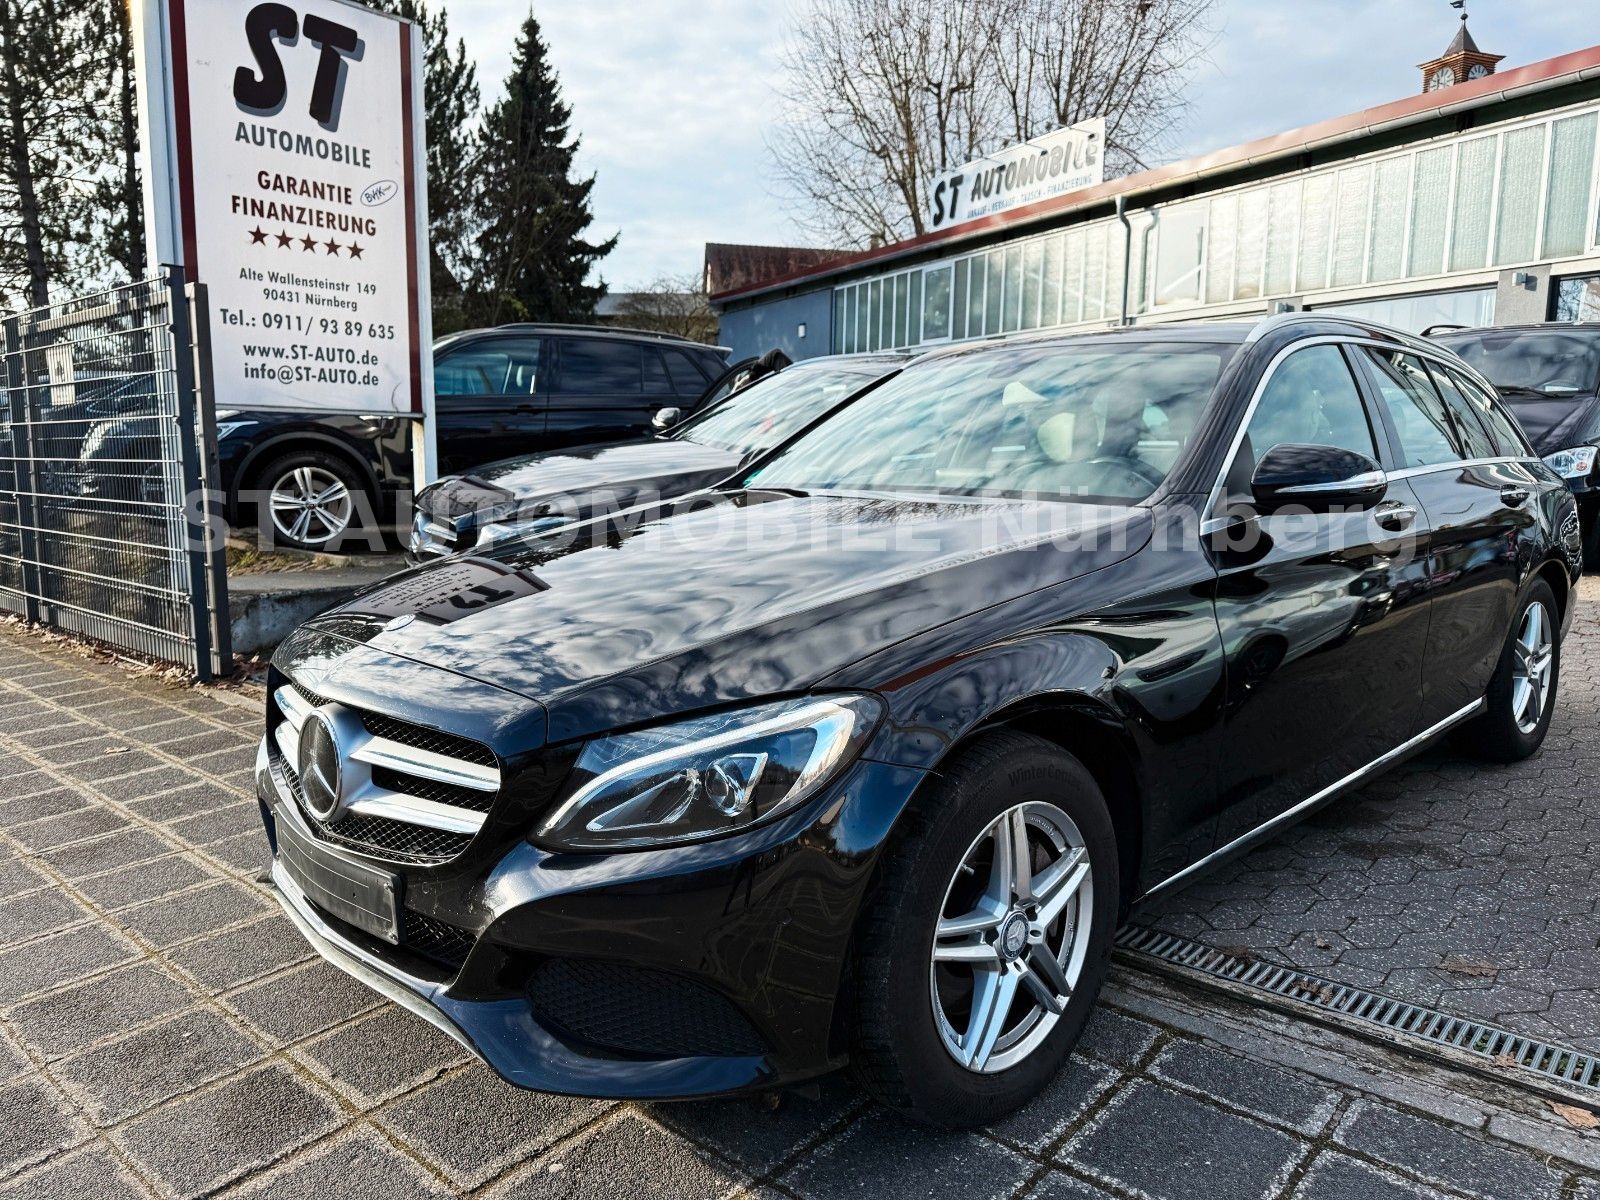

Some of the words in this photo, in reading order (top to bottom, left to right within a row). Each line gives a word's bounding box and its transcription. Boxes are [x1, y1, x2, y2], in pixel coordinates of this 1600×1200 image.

[233, 2, 366, 133] ST
[235, 121, 371, 169] AUTOMOBILE
[257, 170, 353, 206] GARANTIE
[933, 174, 965, 227] ST
[971, 133, 1100, 202] AUTOMOBILE
[231, 195, 376, 237] FINANZIERUNG
[239, 268, 264, 282] Alte
[268, 271, 351, 293] Wallensteinstr
[357, 282, 377, 295] 149
[263, 288, 300, 304] 90431
[305, 292, 358, 312] Nürnberg
[220, 308, 256, 327] Tel.:
[320, 318, 339, 335] 93
[345, 321, 363, 337] 89
[368, 324, 395, 340] 635
[243, 344, 379, 366] www.ST-AUTO.de
[244, 363, 379, 386] info@ST-AUTO.de
